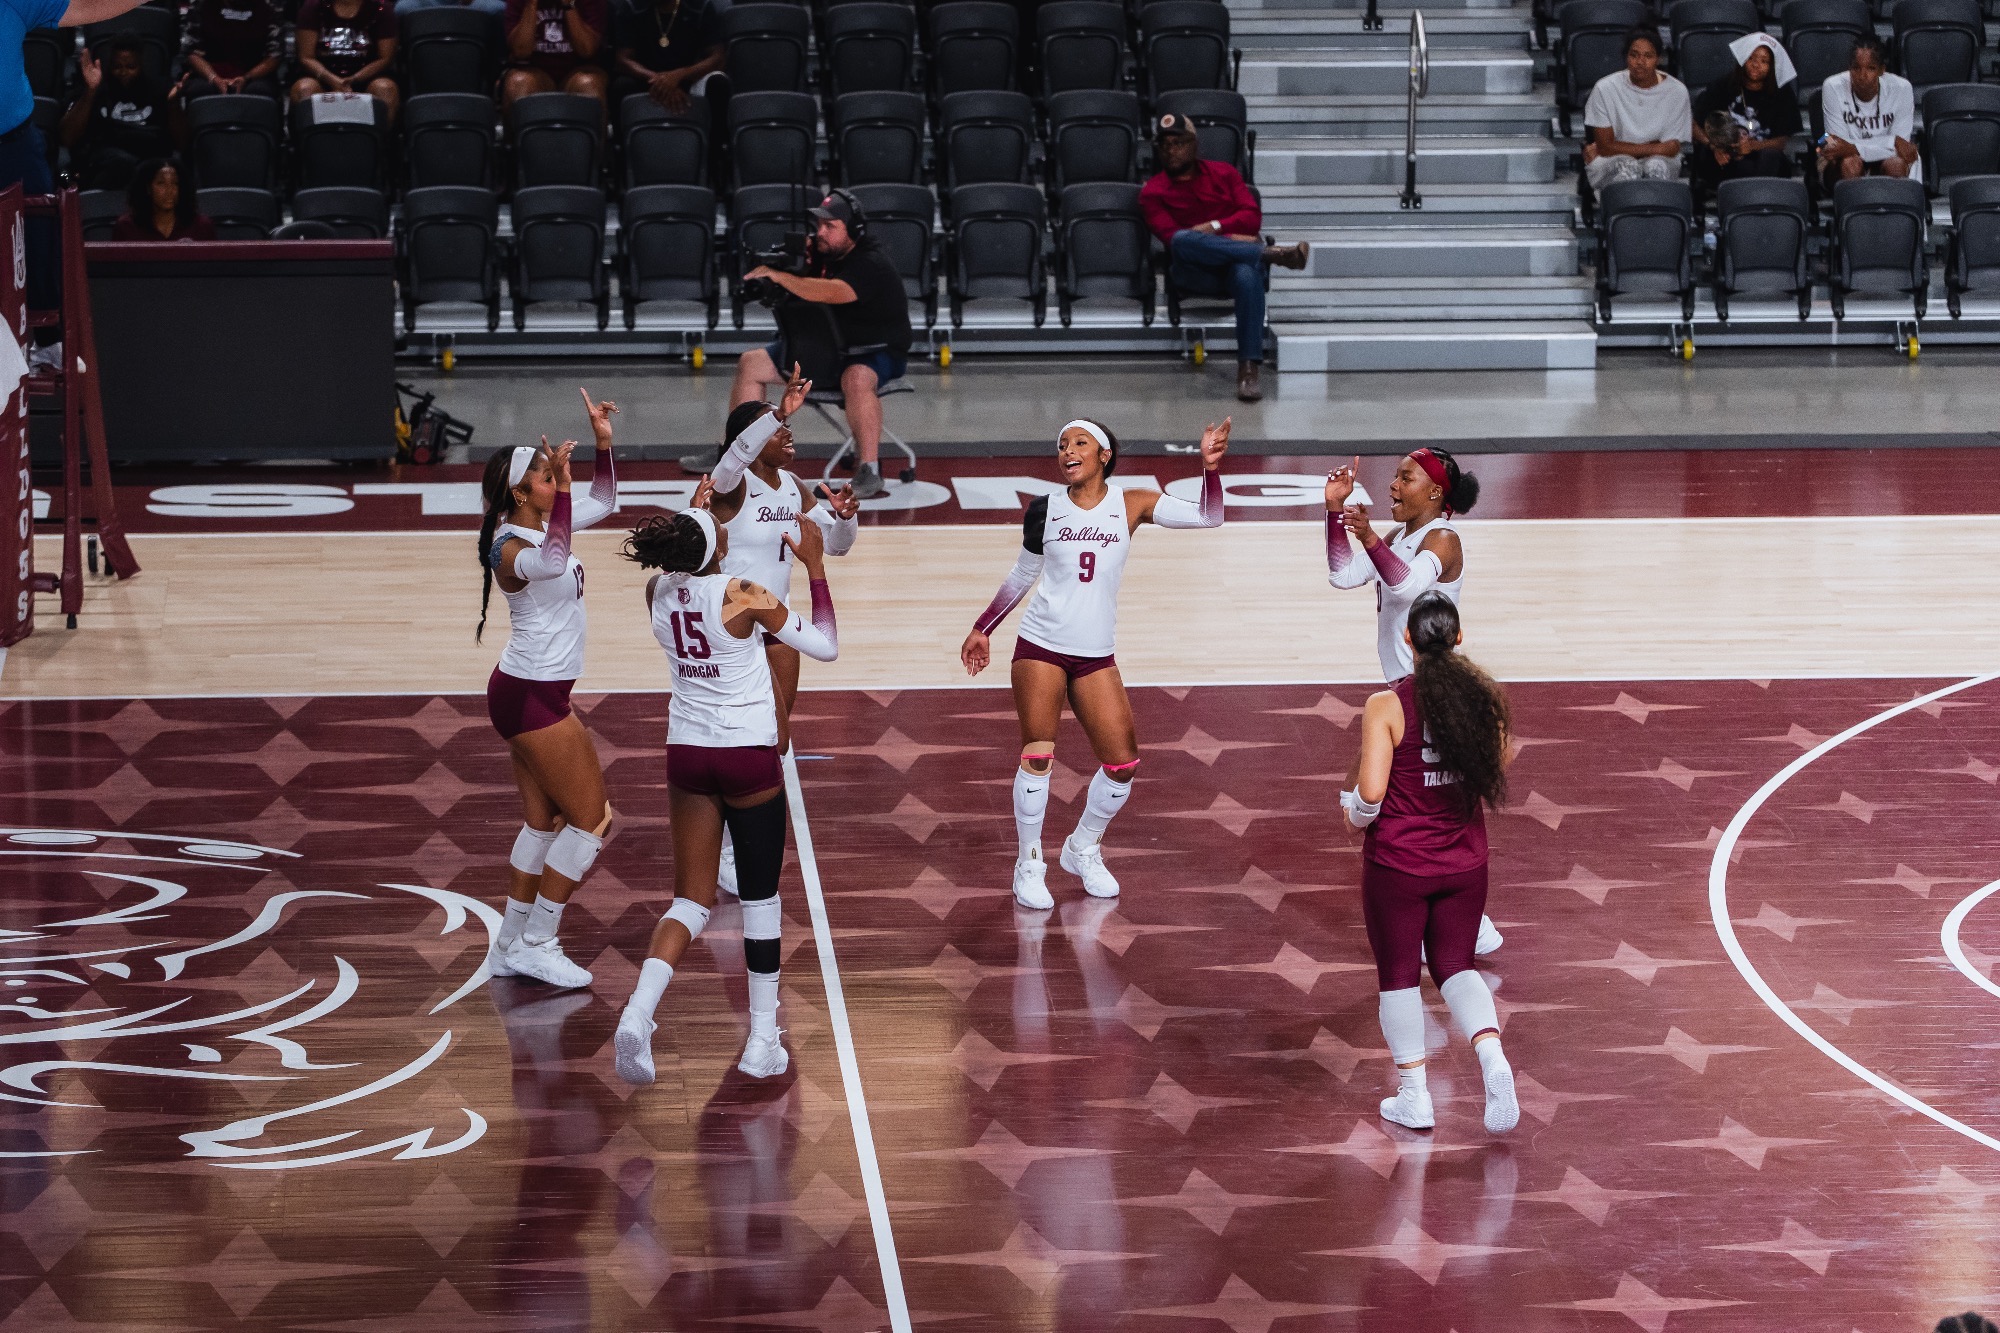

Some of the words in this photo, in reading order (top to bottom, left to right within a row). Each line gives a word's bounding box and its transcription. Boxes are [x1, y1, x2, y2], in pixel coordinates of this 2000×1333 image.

[1869, 113, 1879, 129] IT
[1883, 112, 1894, 127] IN
[756, 506, 798, 528] Bulldo
[1057, 527, 1120, 547] Bulldogs
[1079, 551, 1096, 583] 9
[573, 564, 584, 600] 13
[670, 610, 711, 659] 15
[678, 664, 720, 678] MORGAN
